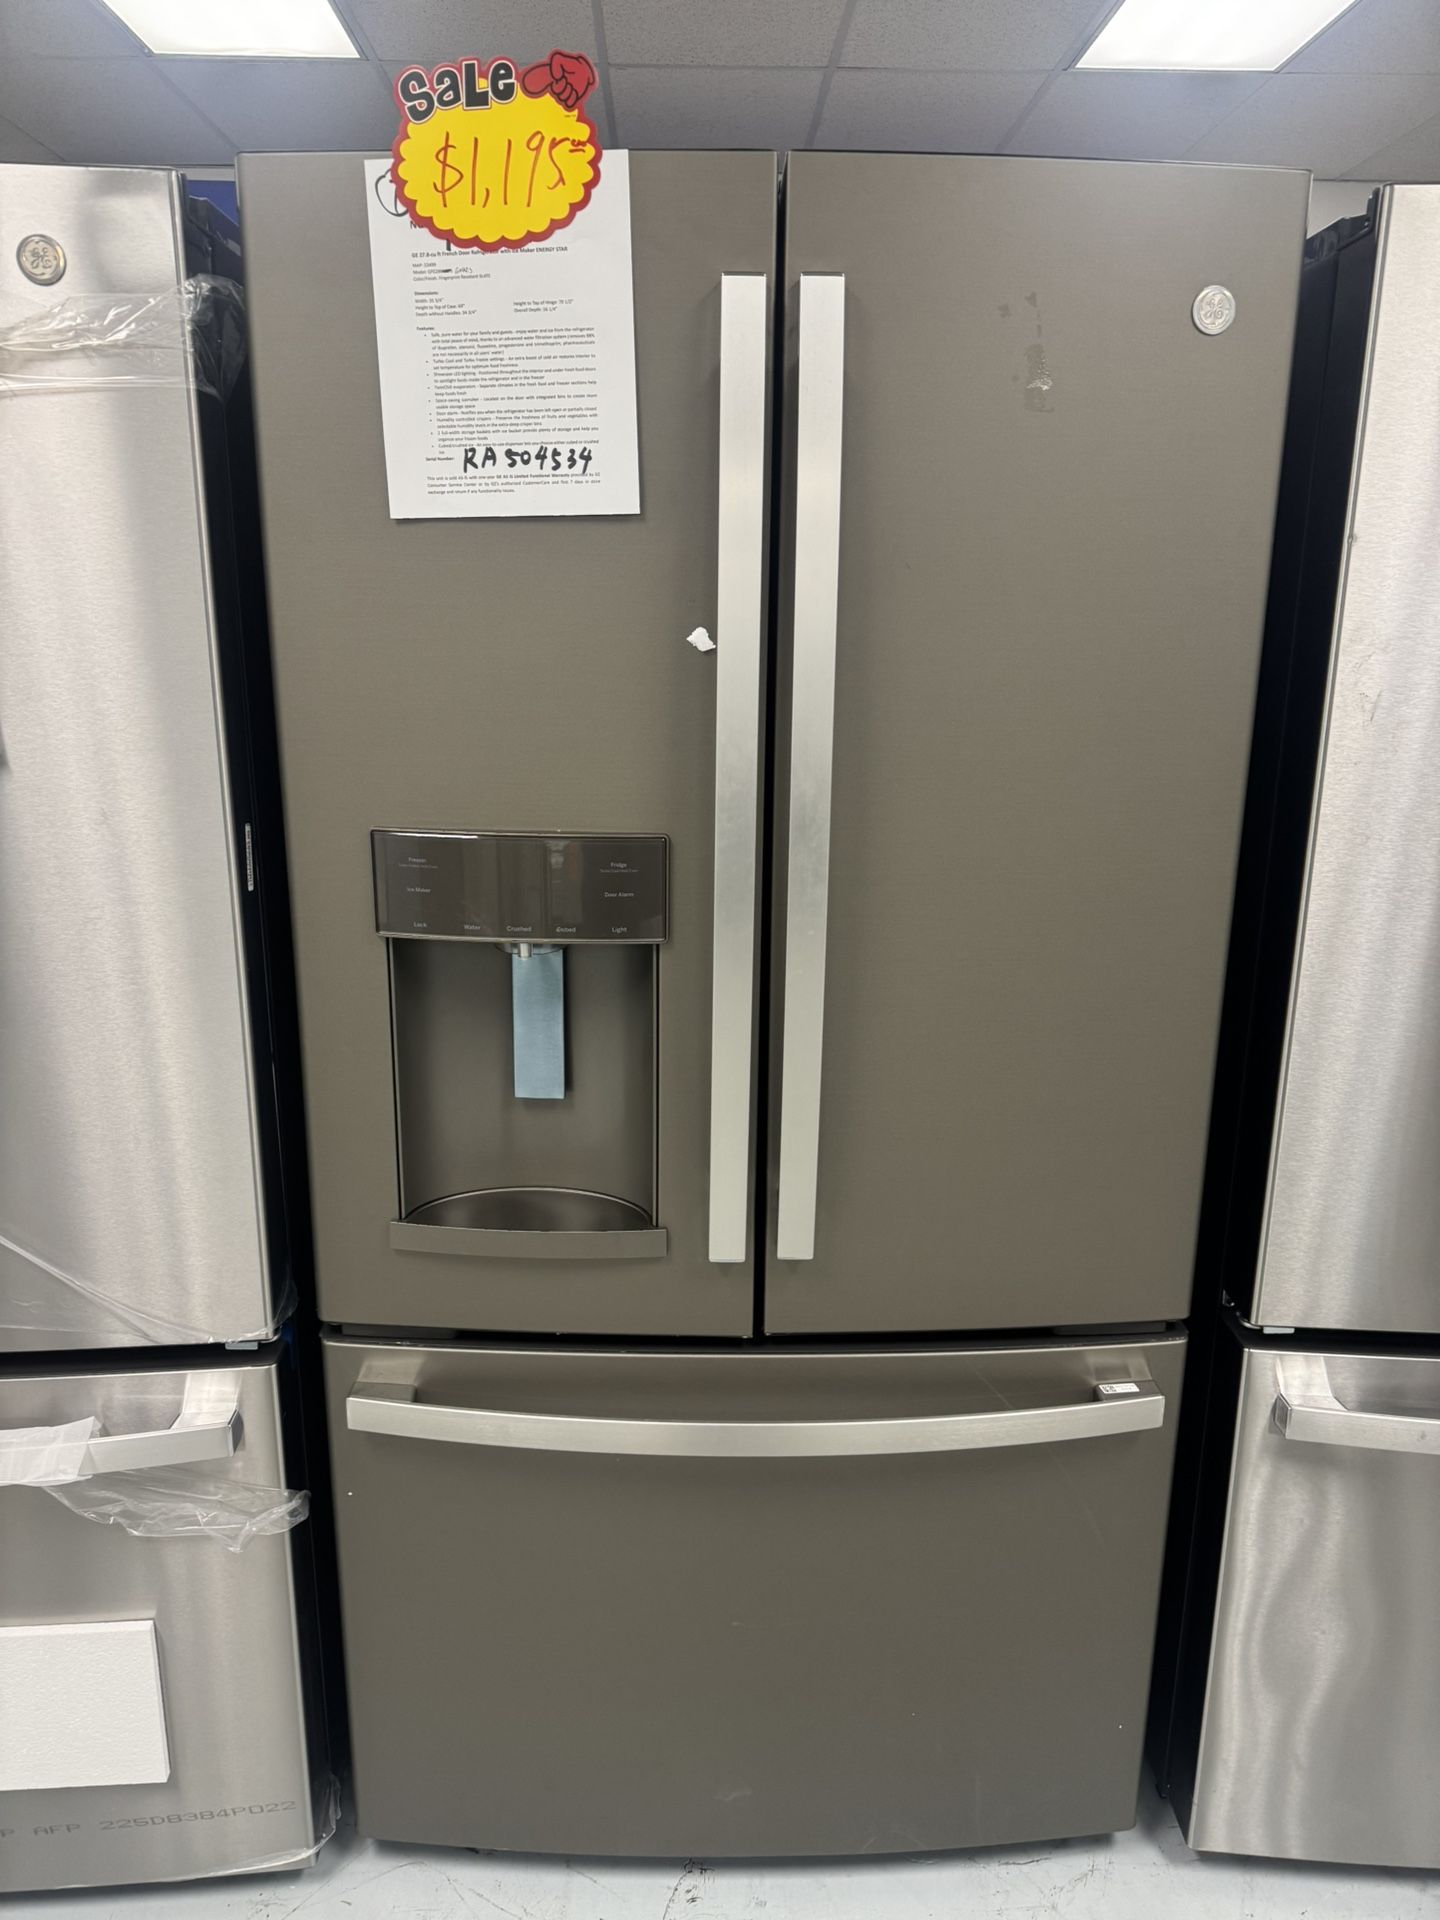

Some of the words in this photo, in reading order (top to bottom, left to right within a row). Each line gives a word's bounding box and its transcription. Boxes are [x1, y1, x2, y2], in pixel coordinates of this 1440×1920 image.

[610, 861, 628, 869] Fridge
[506, 925, 533, 933] Crushed
[612, 926, 628, 934] Light
